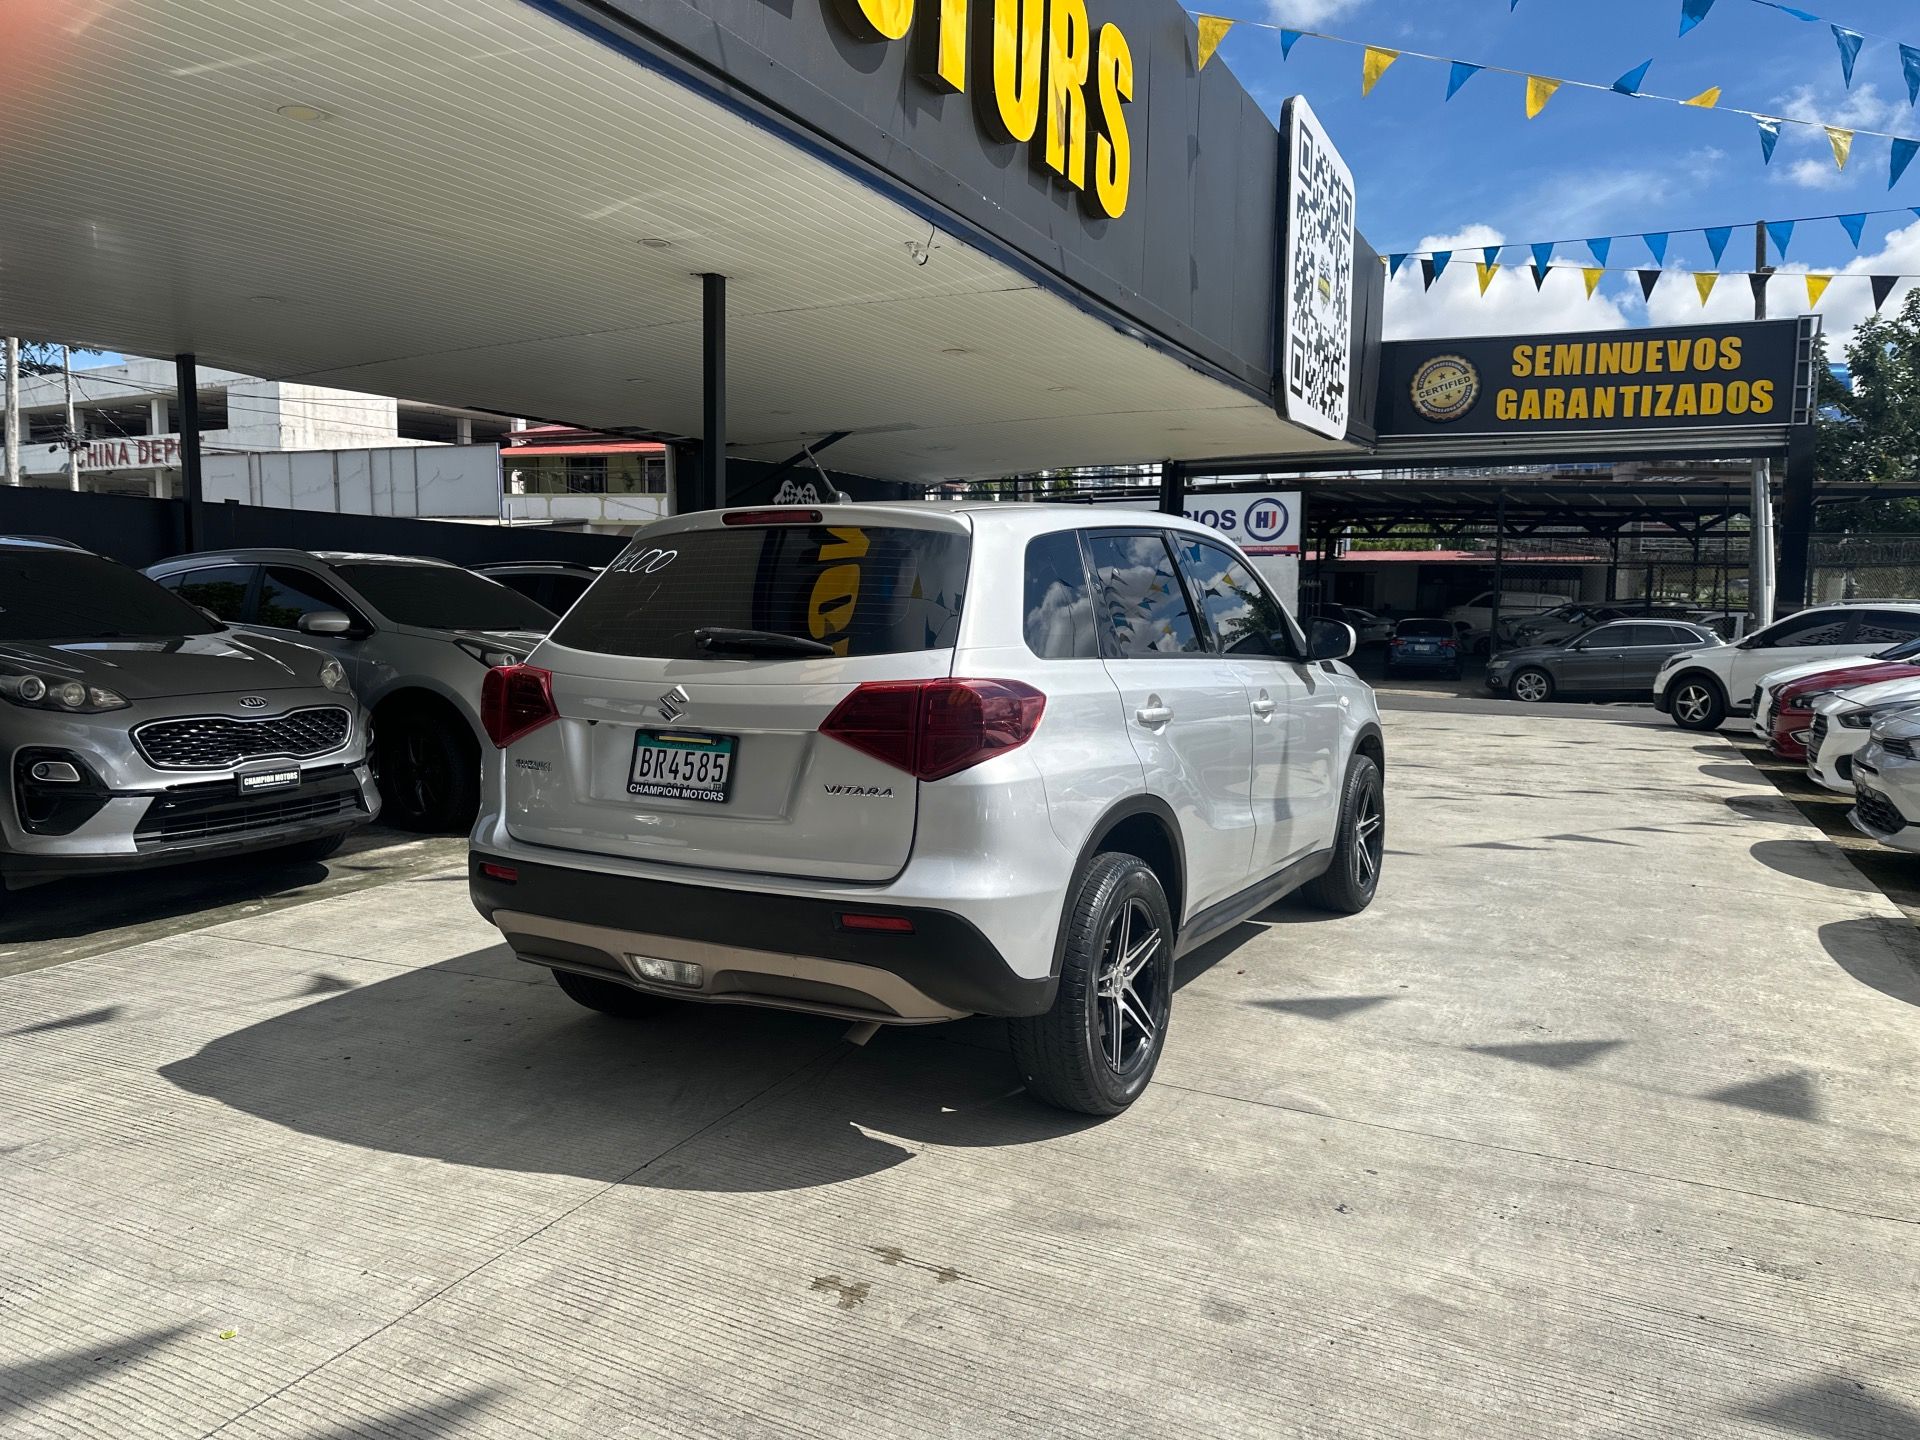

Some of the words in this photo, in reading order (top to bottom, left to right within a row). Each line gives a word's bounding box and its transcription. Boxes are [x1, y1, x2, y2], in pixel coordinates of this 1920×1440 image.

[857, 0, 1133, 218] ORS
[1512, 337, 1742, 377] SEMINUEVOS
[1419, 376, 1471, 399] CERTIFIED
[1496, 380, 1774, 420] GARANTIZADOS
[138, 438, 182, 464] DEP
[1256, 511, 1277, 529] HJ
[639, 748, 725, 782] BR4585
[244, 775, 274, 786] CHAMPION
[275, 772, 298, 782] MOTORS
[824, 784, 894, 798] VITARA
[629, 783, 680, 797] CHAMPION
[682, 788, 724, 801] MOTORS
